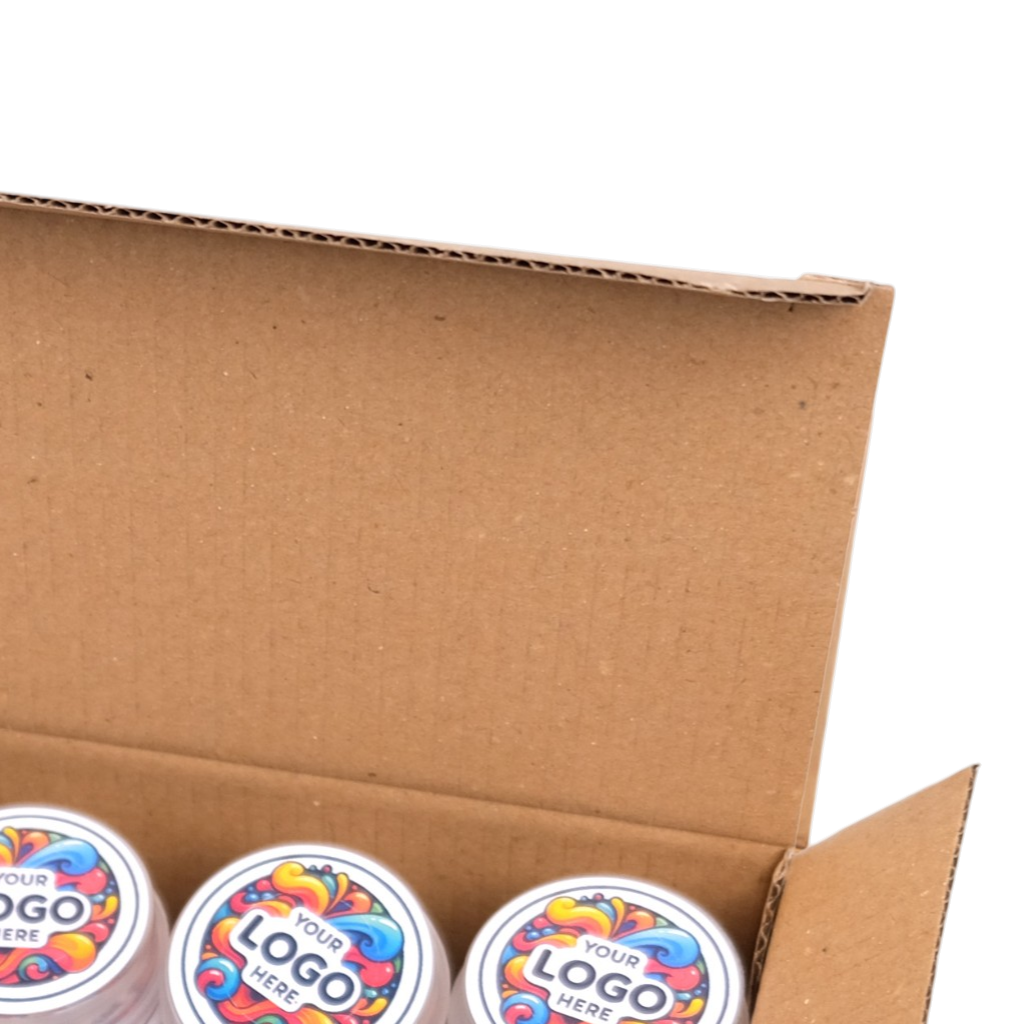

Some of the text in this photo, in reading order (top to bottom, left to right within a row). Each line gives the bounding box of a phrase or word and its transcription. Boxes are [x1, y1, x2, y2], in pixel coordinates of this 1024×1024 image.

[295, 912, 344, 954] YOUR
[237, 914, 355, 1006] LOGO
[584, 939, 641, 969] YOUR
[249, 965, 300, 1005] HERE
[531, 948, 667, 1015] LOGO
[556, 993, 614, 1022] HERE
